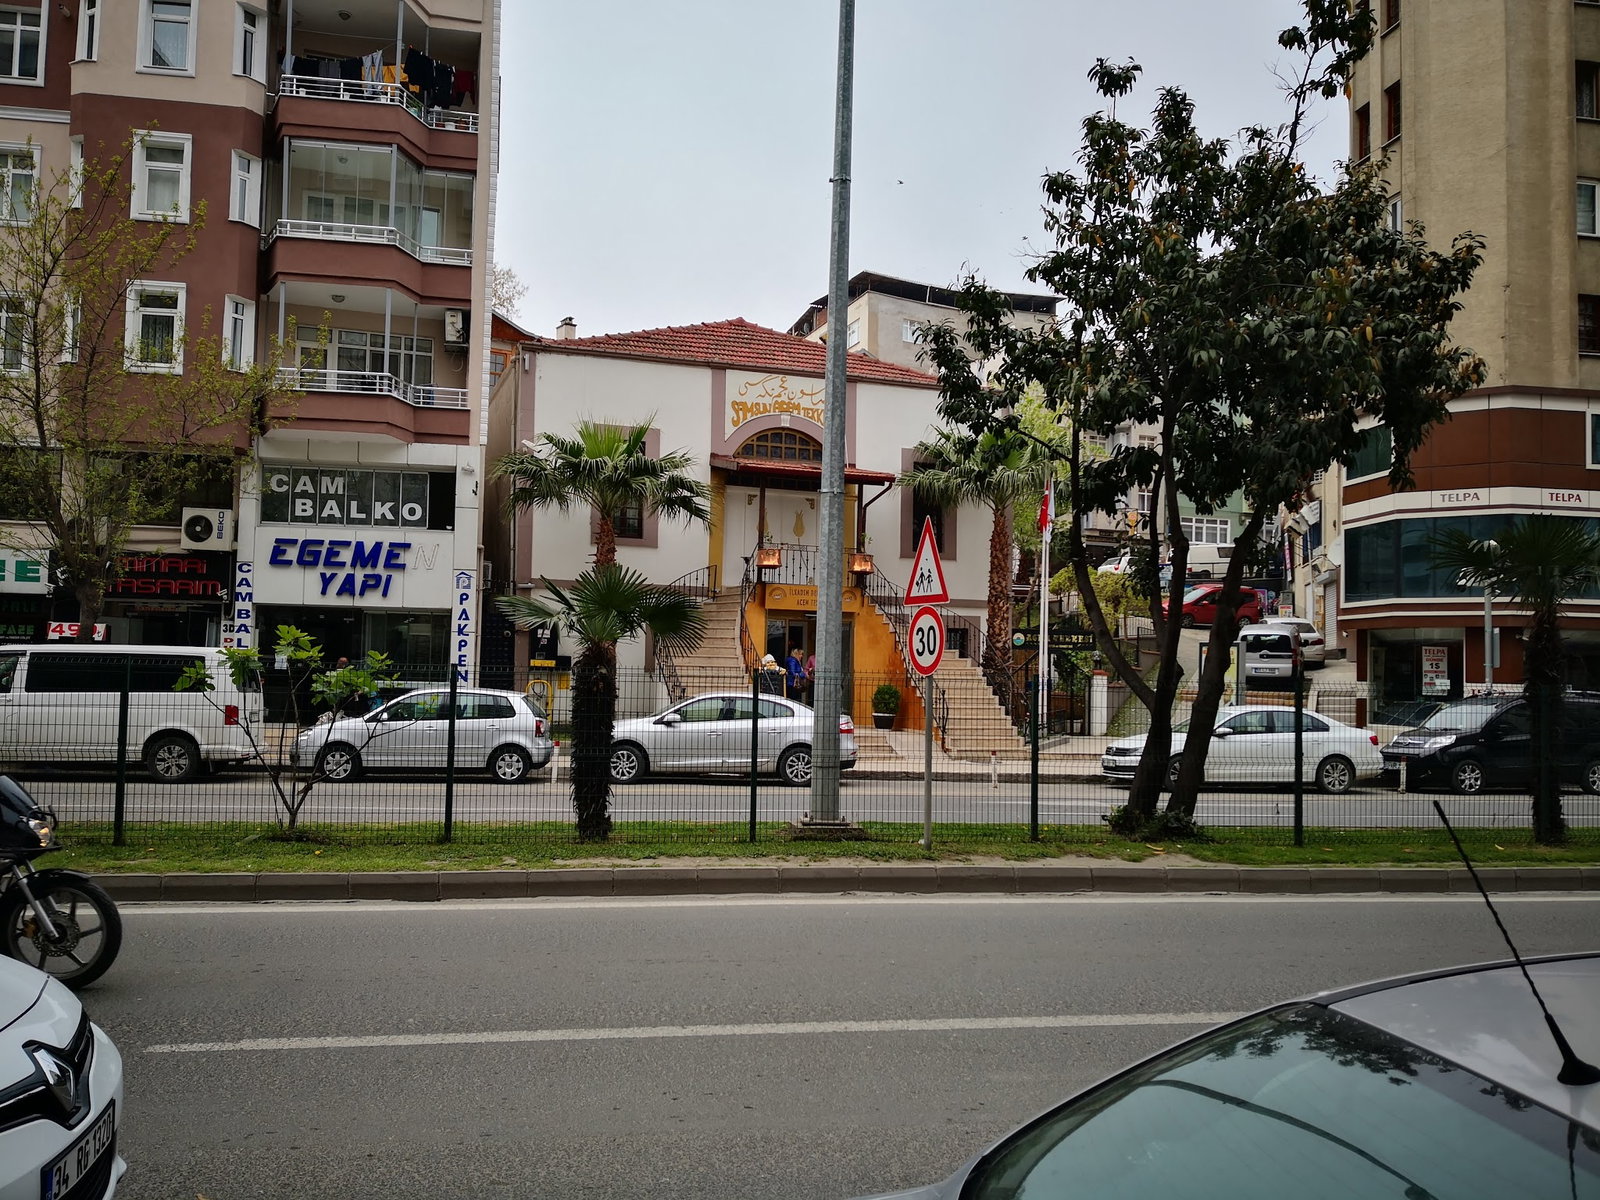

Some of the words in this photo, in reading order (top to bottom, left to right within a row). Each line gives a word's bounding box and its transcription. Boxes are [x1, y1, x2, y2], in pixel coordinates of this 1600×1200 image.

[802, 407, 825, 426] TEKK
[270, 474, 345, 494] CAM
[1440, 492, 1480, 503] TELPA
[1548, 492, 1582, 503] TELPA
[294, 499, 422, 521] BALKO
[216, 511, 224, 540] BEKO
[0, 560, 41, 582] E
[319, 572, 393, 598] YAPI
[222, 623, 235, 633] 3D
[456, 592, 471, 683] PAKPEN
[915, 625, 937, 657] 30
[53, 1160, 69, 1199] 34
[76, 1138, 91, 1180] RG
[92, 1112, 112, 1159] 1320
